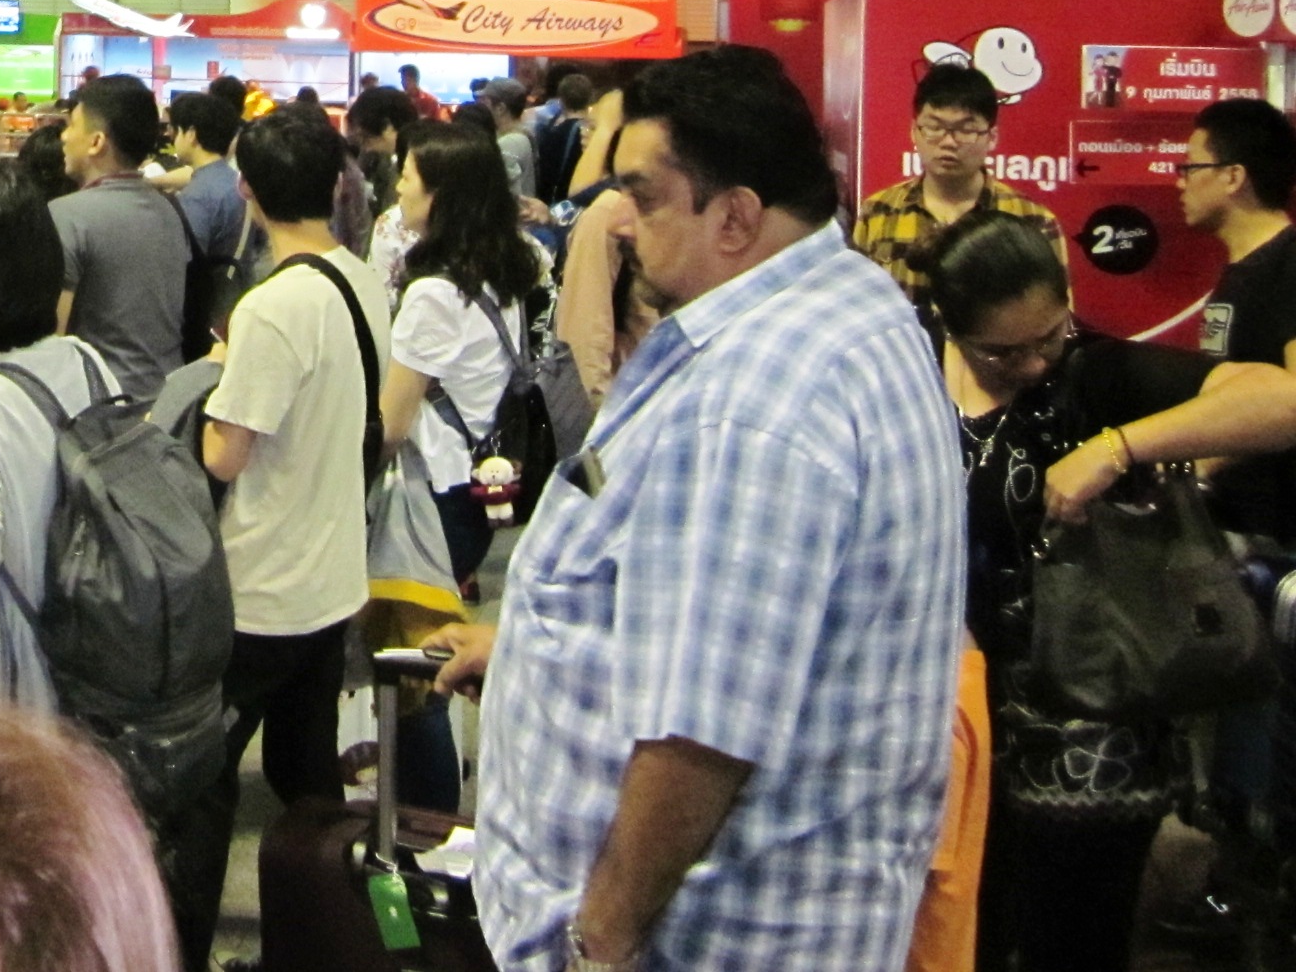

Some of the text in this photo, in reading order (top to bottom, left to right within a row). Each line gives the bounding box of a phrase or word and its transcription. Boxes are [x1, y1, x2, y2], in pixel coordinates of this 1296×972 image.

[462, 5, 625, 38] City Airways
[1160, 52, 1217, 77] เริ่มบิน
[1125, 86, 1136, 99] 9
[1143, 84, 1212, 104] กุมภาพันธ์
[1091, 224, 1114, 254] 2
